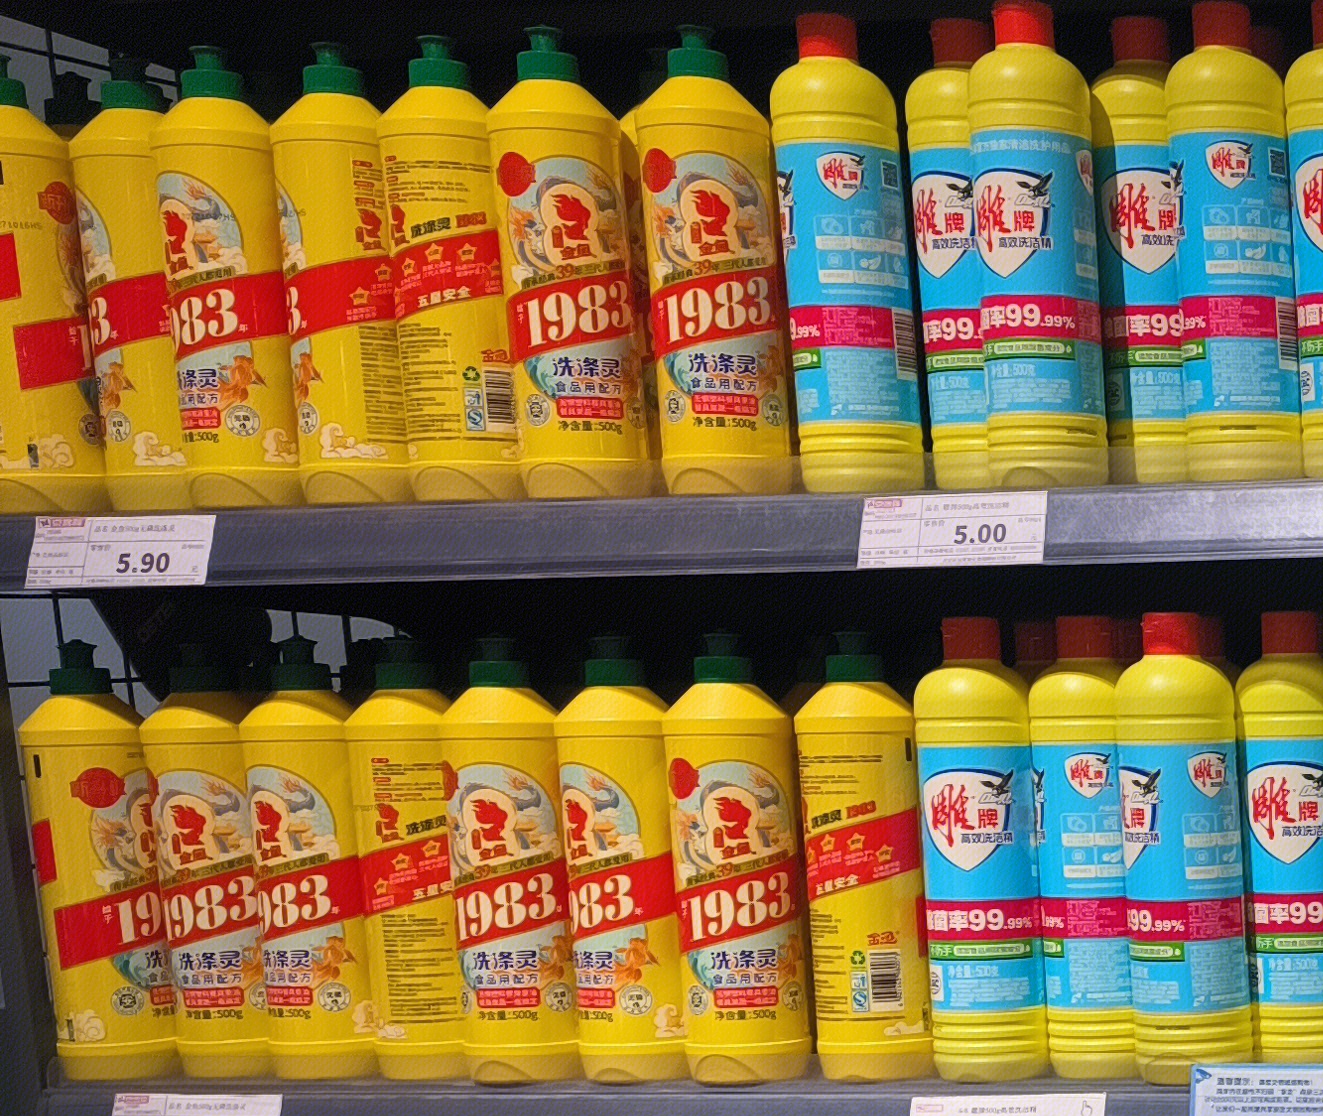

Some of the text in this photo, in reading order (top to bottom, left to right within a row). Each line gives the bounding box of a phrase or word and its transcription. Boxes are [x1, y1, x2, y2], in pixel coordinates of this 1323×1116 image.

[526, 281, 631, 348] 1983
[665, 277, 771, 344] 1983
[552, 356, 621, 379] 洗涤灵
[555, 381, 622, 394] 食品用配方
[954, 524, 1006, 544] 5.00
[116, 553, 170, 573] 5.90
[961, 832, 1012, 844] 高效洗洁精
[178, 950, 242, 970] 洗涤灵
[710, 950, 777, 970] 洗涤灵
